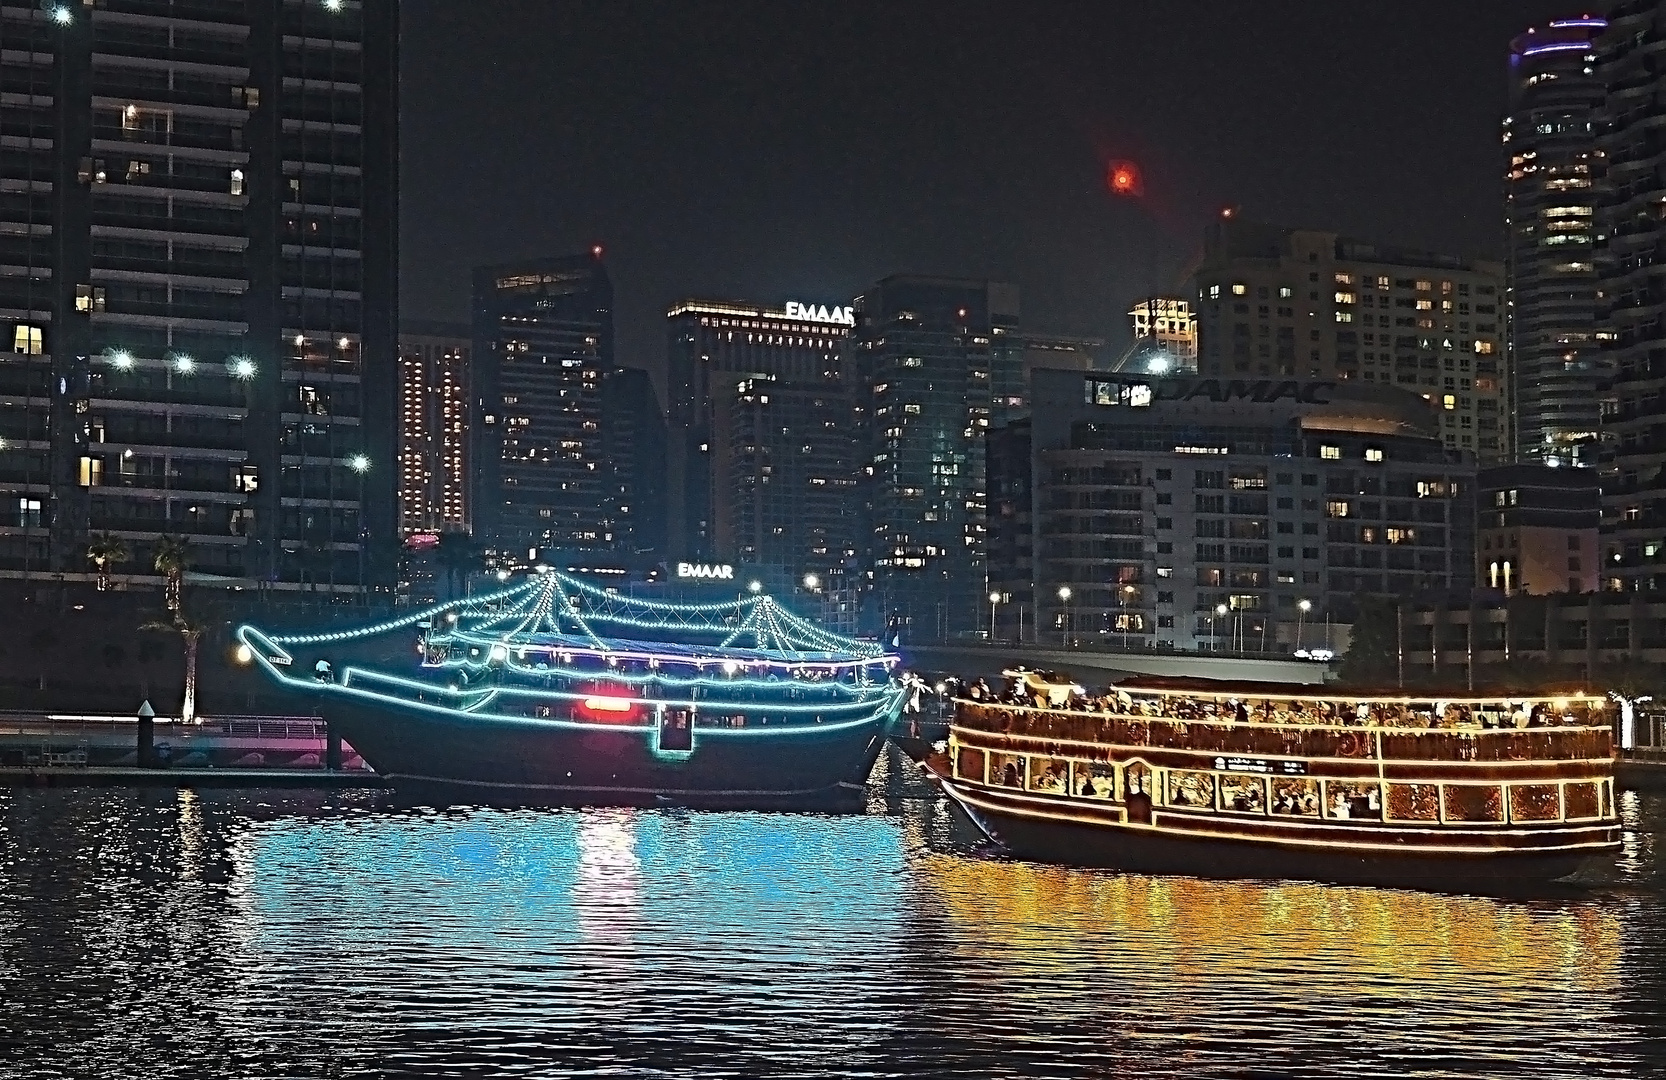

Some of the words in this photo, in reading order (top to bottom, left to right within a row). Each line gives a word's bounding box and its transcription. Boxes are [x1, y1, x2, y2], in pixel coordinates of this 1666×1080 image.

[786, 301, 855, 327] EMAAR
[1155, 378, 1336, 404] DAMAC
[678, 562, 734, 579] EMAAR
